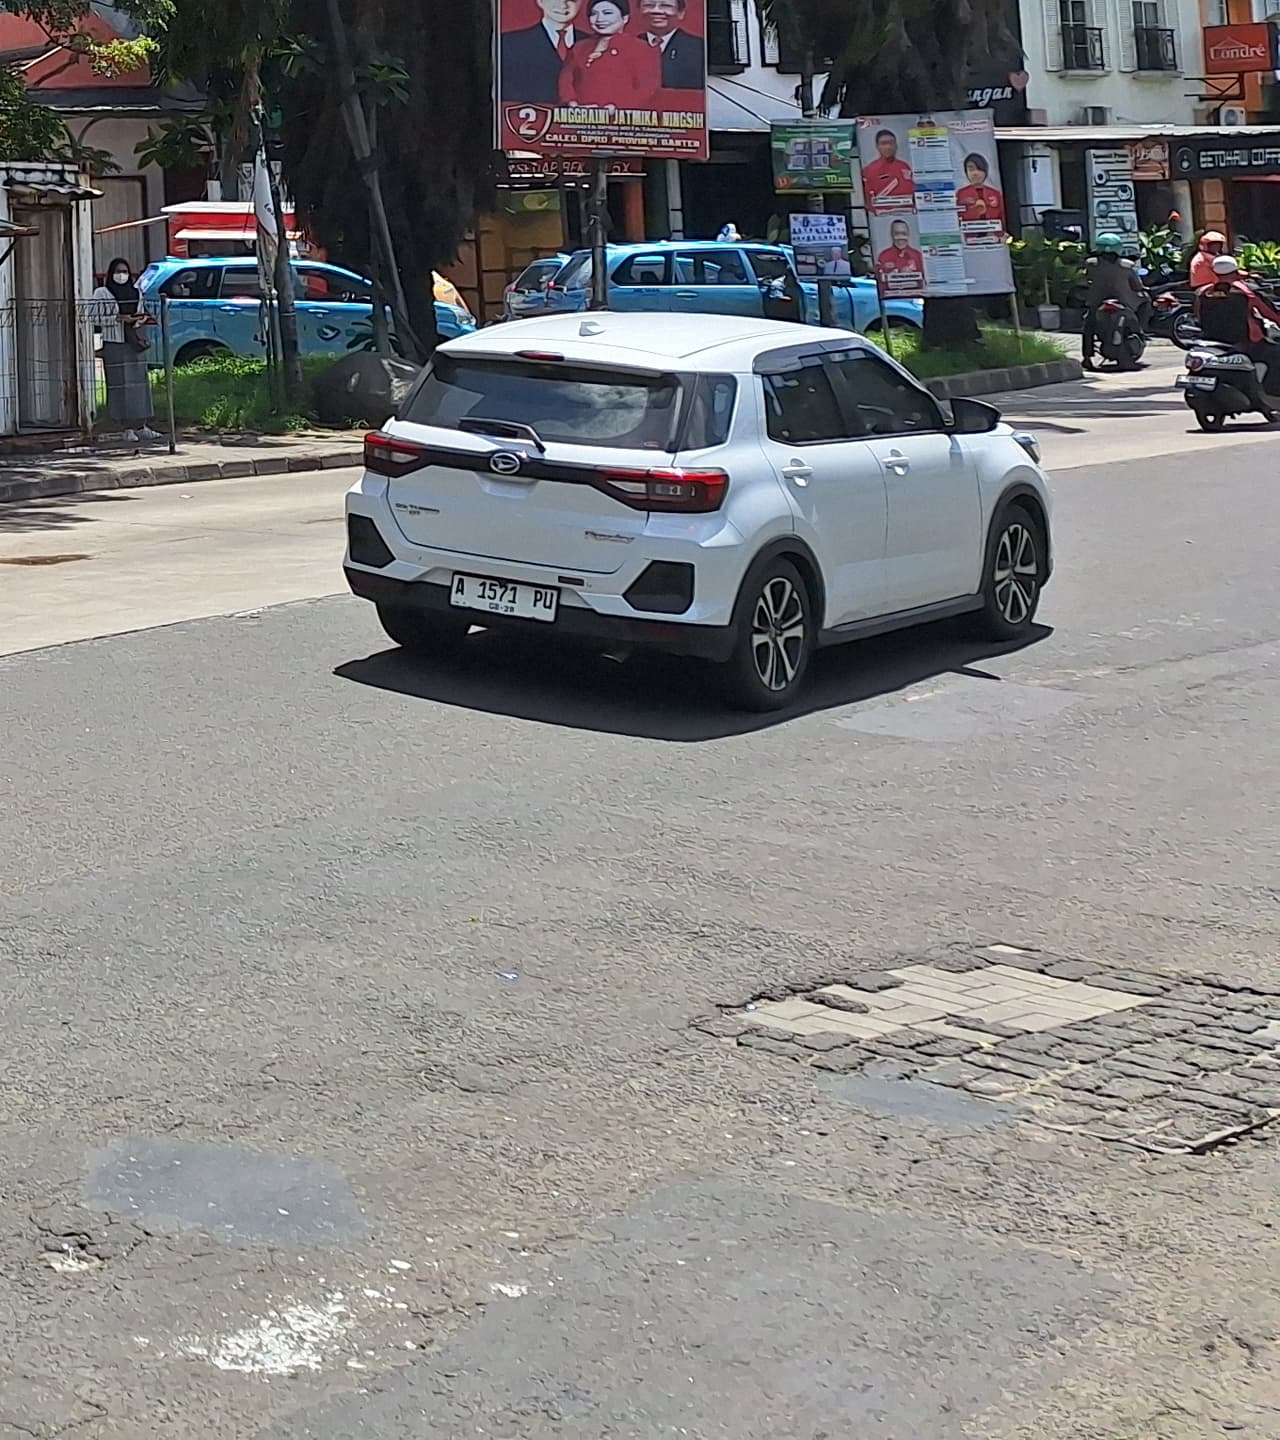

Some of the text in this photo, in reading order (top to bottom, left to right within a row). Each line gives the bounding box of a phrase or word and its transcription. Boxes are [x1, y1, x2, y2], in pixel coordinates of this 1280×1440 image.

[518, 108, 537, 135] 2
[553, 108, 704, 129] ANGGRAINI JATMIKA NINGSIH
[545, 134, 578, 143] CALEG
[611, 137, 658, 147] PROVINSI
[455, 577, 555, 610] A 1571 PU
